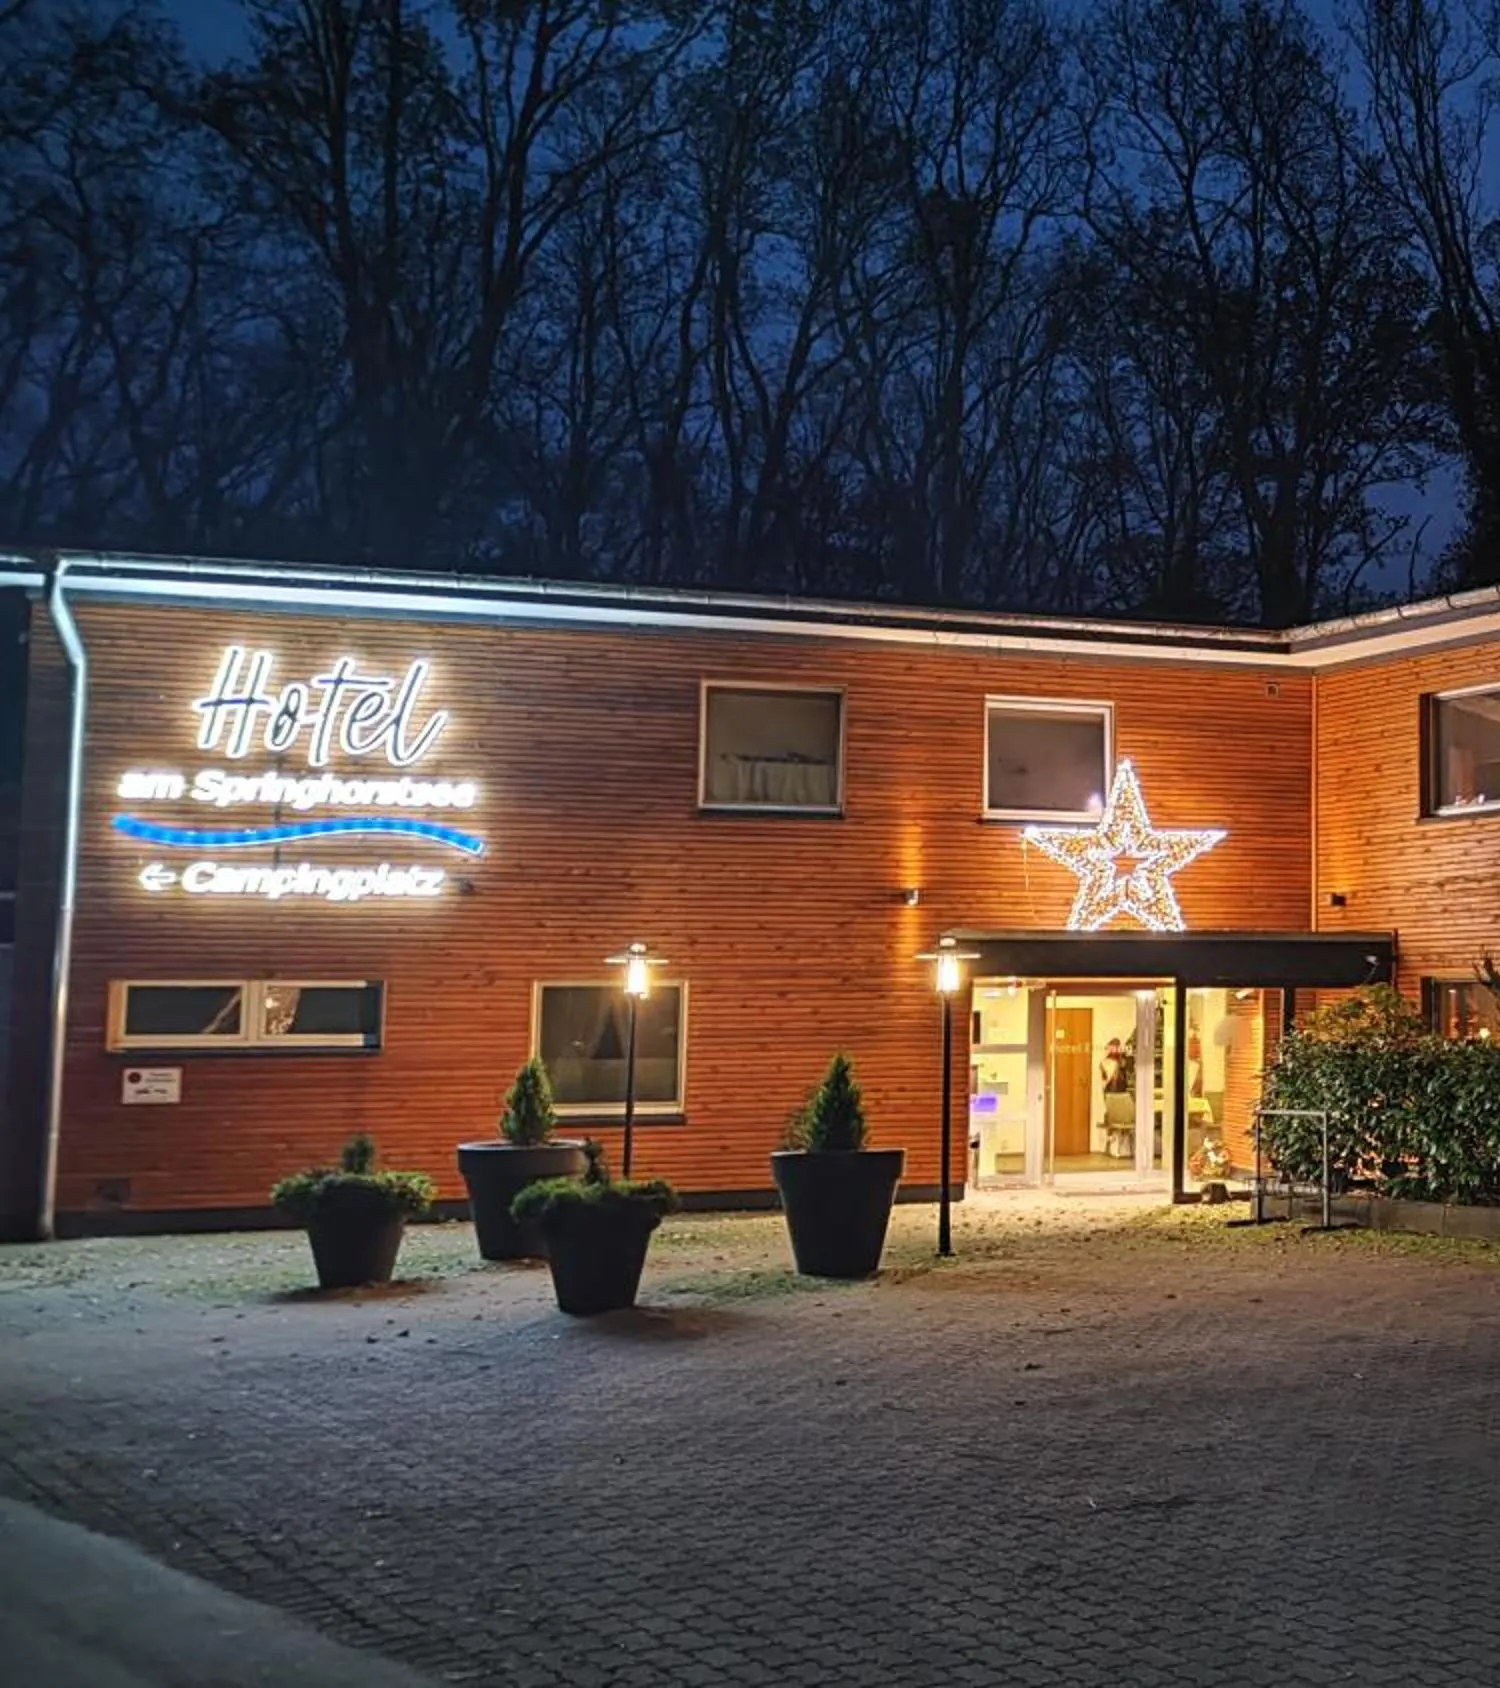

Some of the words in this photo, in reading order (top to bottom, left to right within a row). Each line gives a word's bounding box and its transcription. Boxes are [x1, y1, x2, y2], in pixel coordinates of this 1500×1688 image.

[194, 645, 449, 765] Hotel
[118, 772, 185, 799] am
[191, 769, 477, 810] Springhorstsee
[182, 861, 446, 900] Campingplatz
